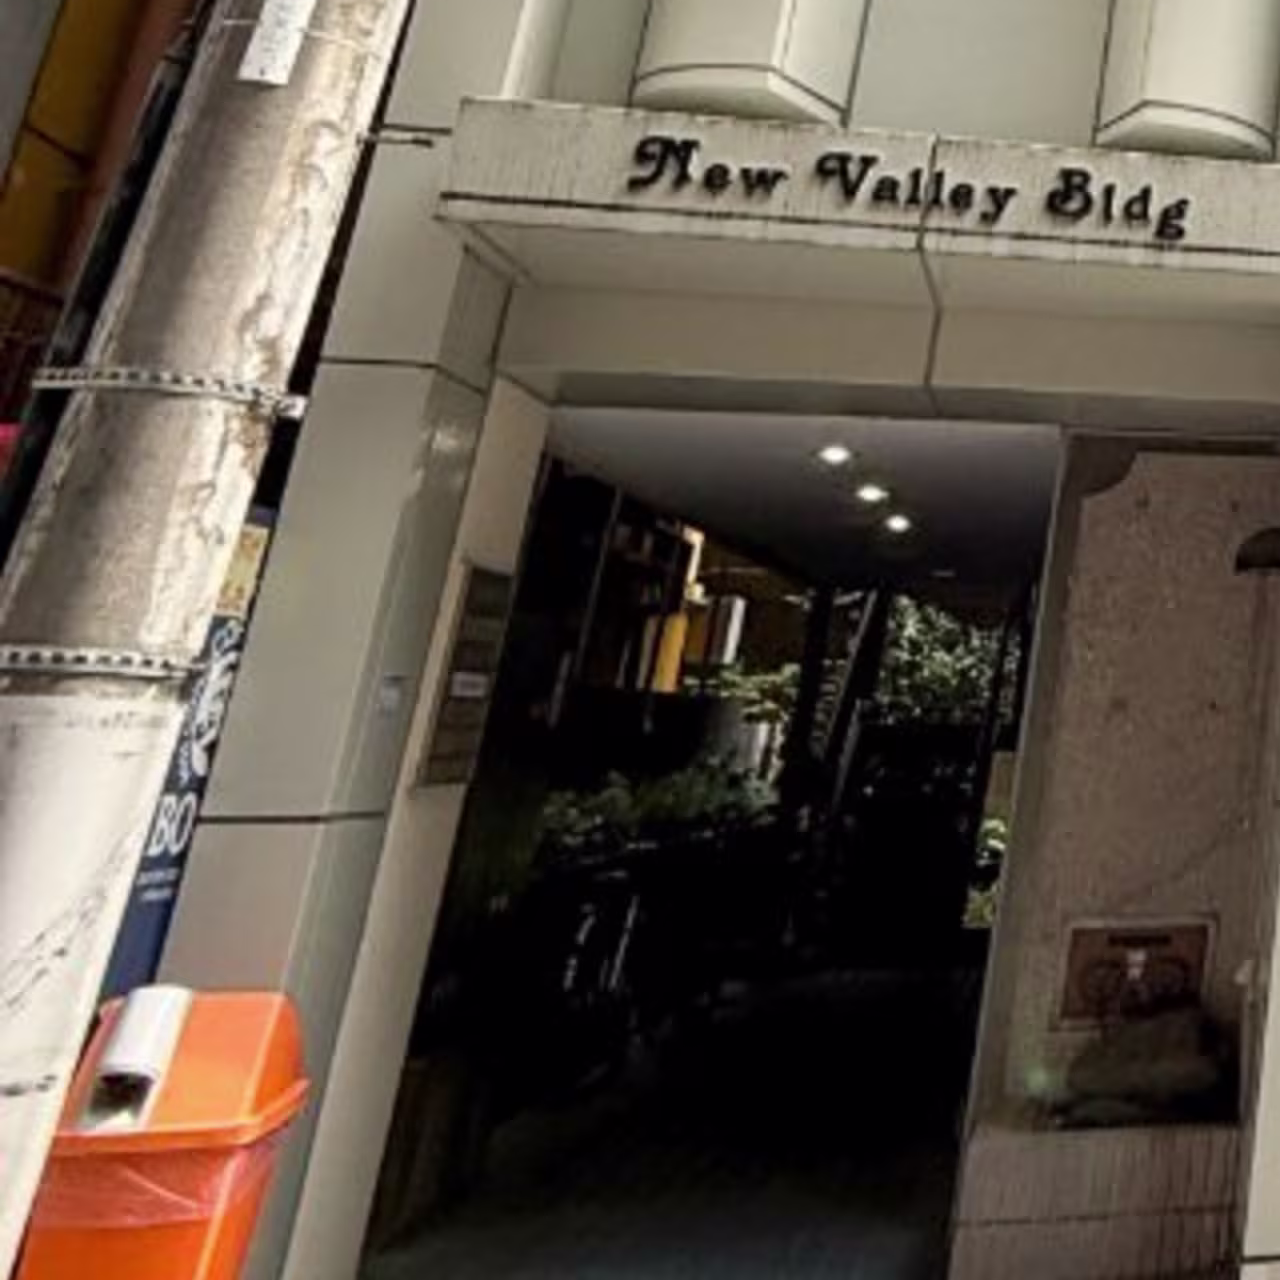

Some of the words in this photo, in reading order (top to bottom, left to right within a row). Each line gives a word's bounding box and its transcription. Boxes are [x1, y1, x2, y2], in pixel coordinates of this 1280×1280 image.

[626, 135, 790, 193] New
[814, 151, 1019, 224] Valley
[1045, 166, 1191, 241] Bldg
